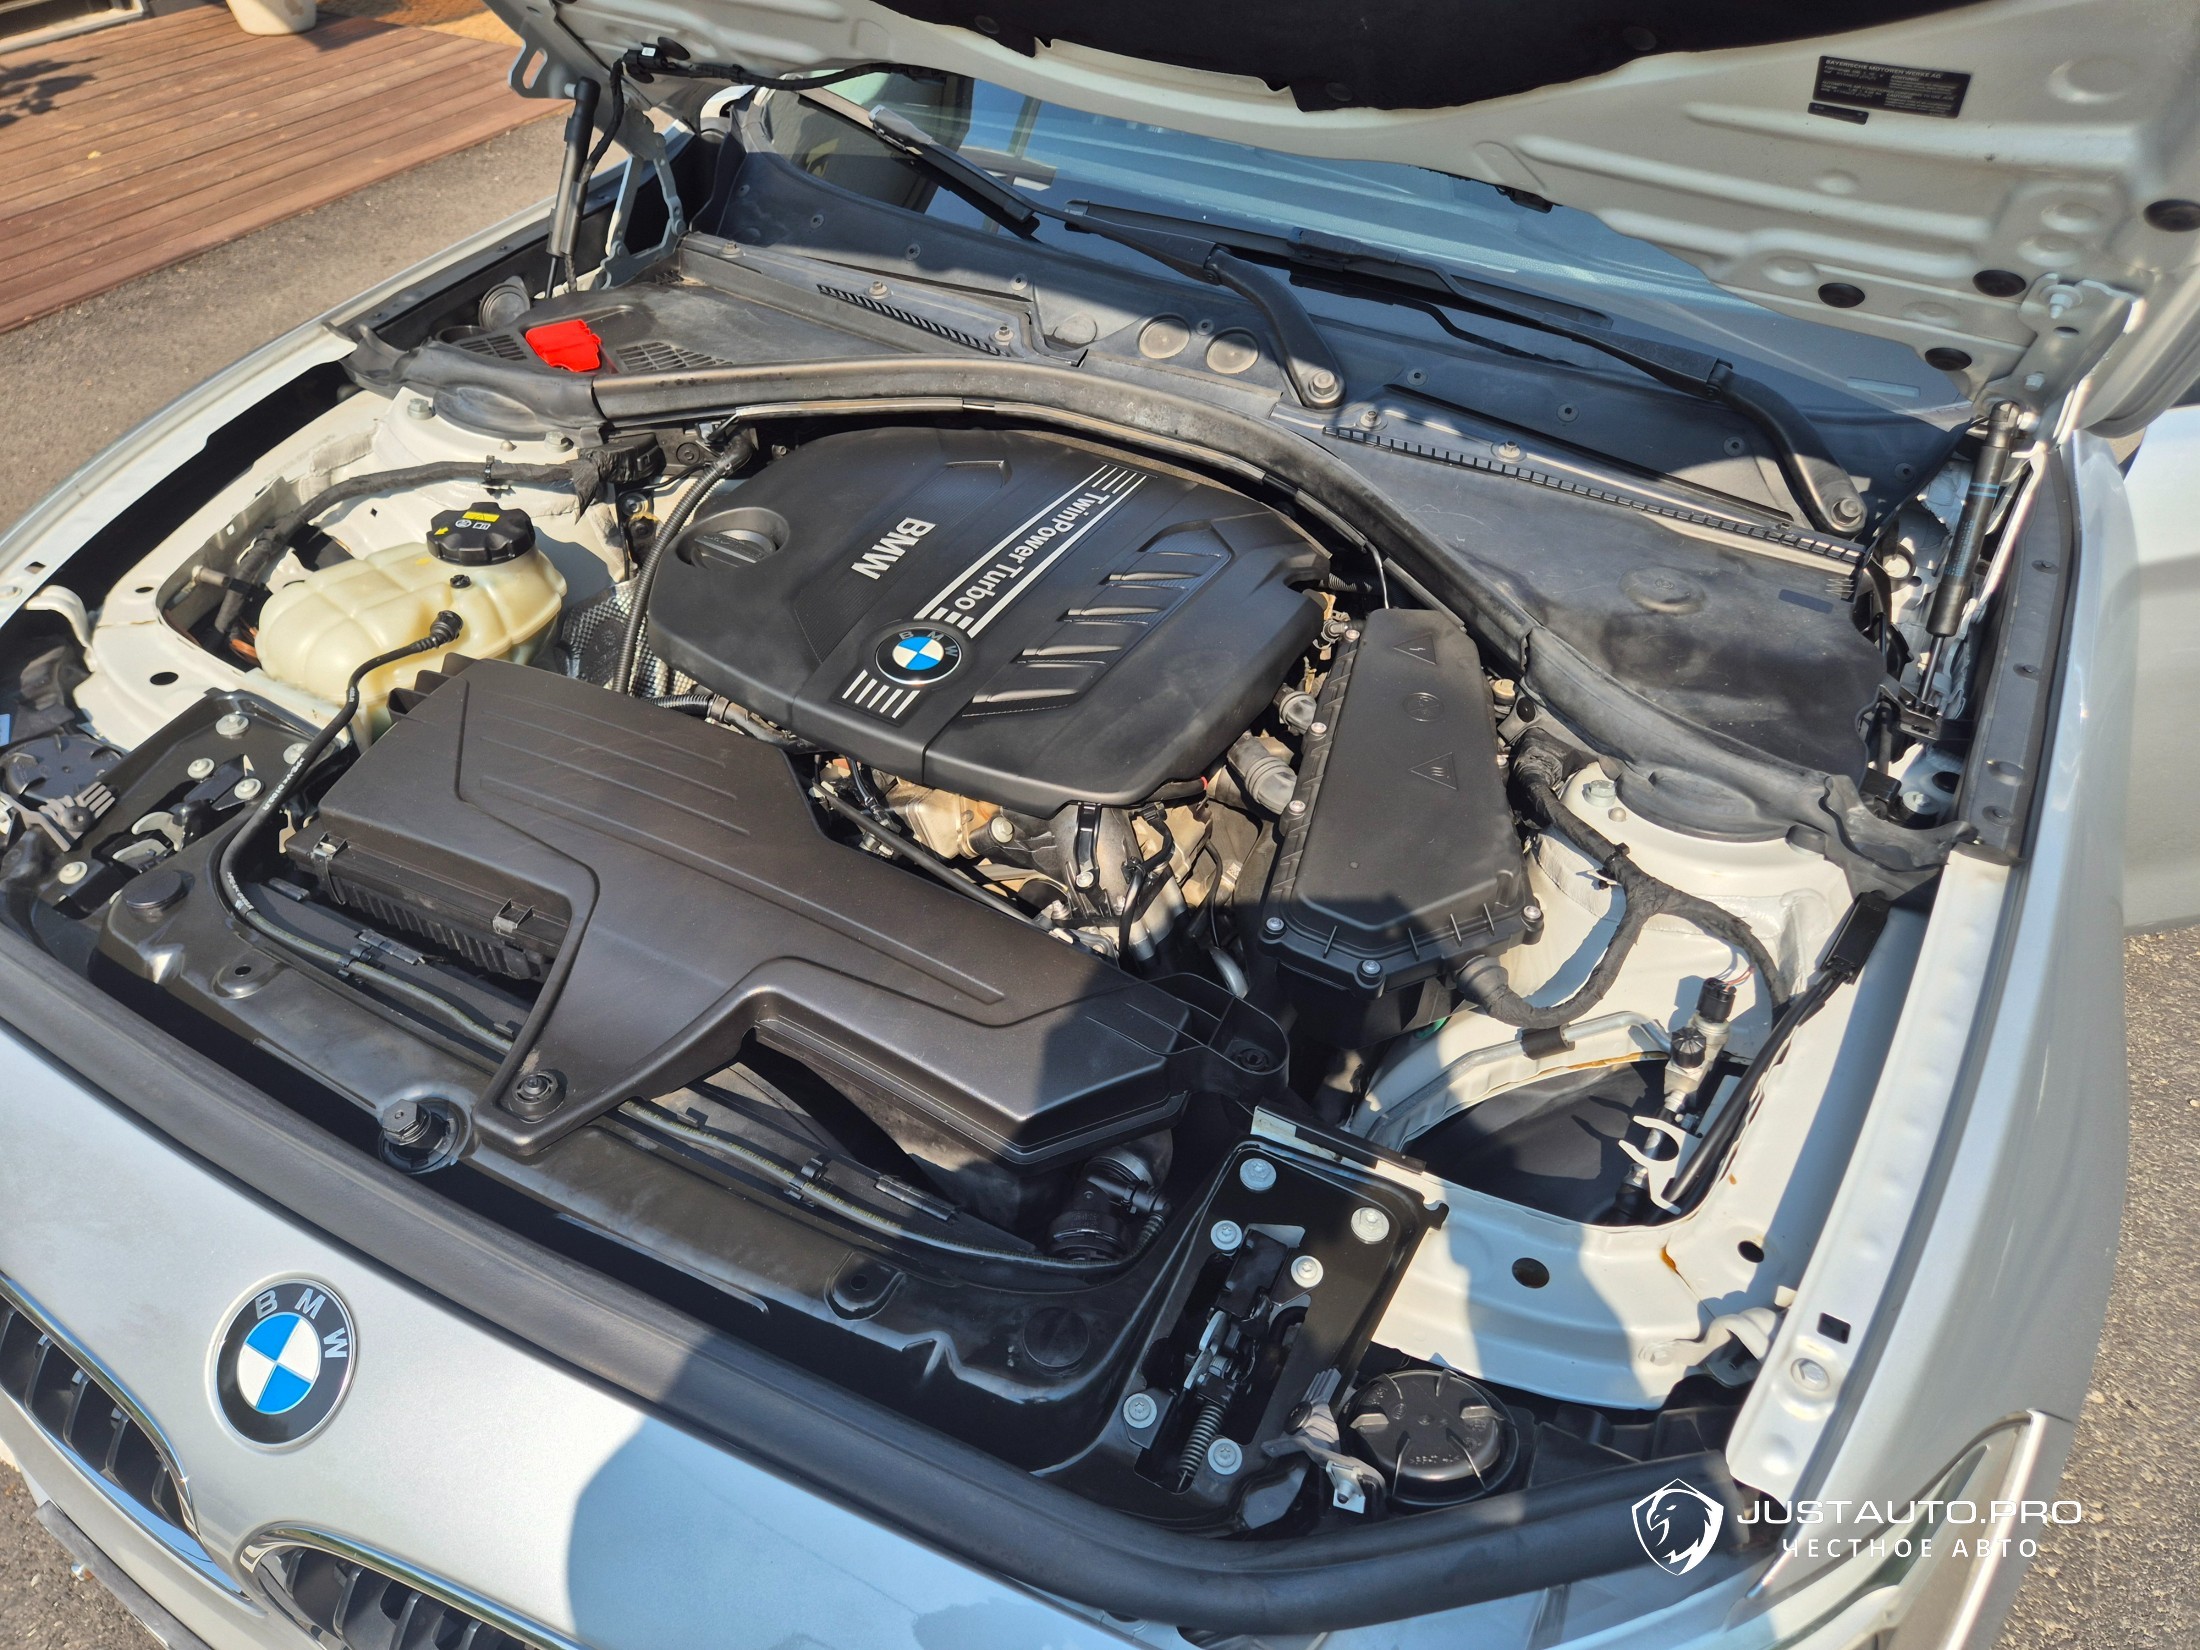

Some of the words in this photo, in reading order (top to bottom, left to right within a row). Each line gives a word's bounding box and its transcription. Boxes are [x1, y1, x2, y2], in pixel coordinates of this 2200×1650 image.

[851, 516, 937, 580] BMW
[1008, 492, 1110, 564] TwinPower
[954, 564, 1025, 610] Turbo
[898, 630, 960, 657] BMW
[255, 1287, 348, 1358] BMW
